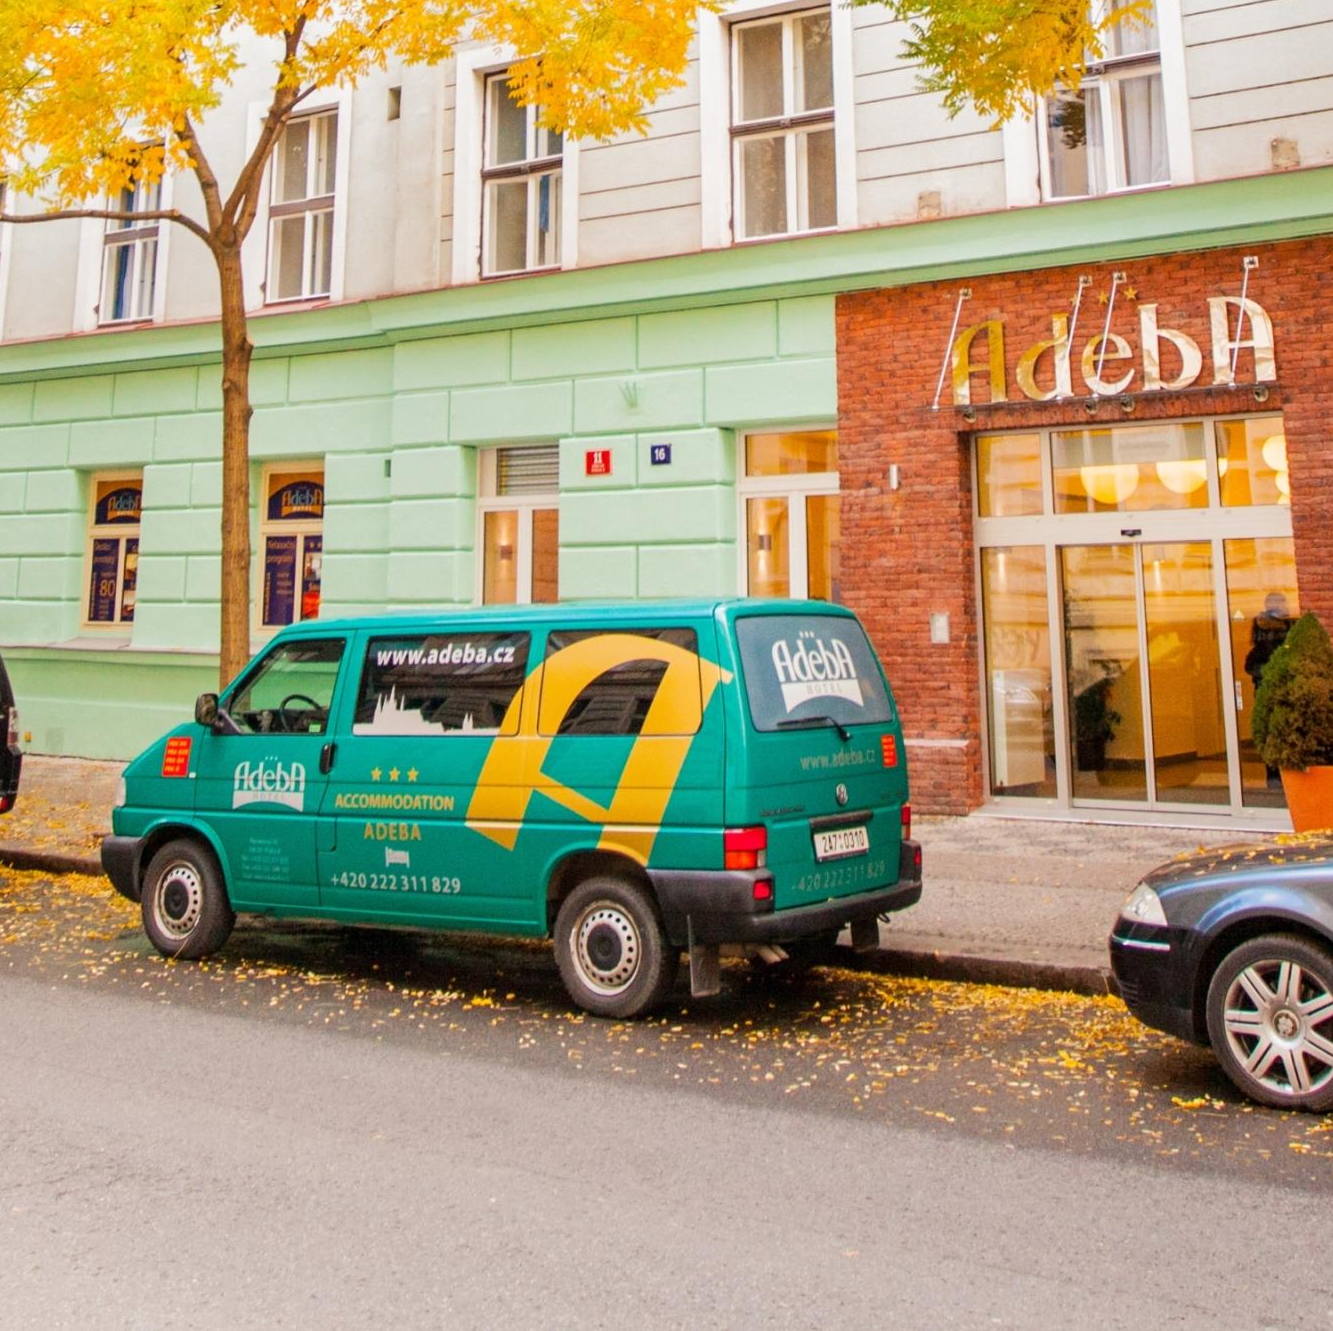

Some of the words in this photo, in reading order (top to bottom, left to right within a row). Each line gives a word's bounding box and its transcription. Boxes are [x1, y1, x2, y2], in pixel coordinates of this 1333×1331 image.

[952, 296, 1277, 406] AdebA
[654, 448, 666, 461] 16
[99, 579, 116, 597] 80
[375, 643, 516, 667] www.adeba.cz
[771, 637, 857, 683] AdebA
[806, 682, 843, 695] HOTEL
[800, 748, 876, 770] www.adeba.cz
[234, 761, 306, 793] AdebA
[334, 793, 455, 812] ACCOMMODATION
[363, 822, 422, 841] ADEBA
[331, 872, 367, 889] +420
[370, 874, 398, 891] 222
[401, 876, 427, 893] 311
[431, 877, 462, 894] 829
